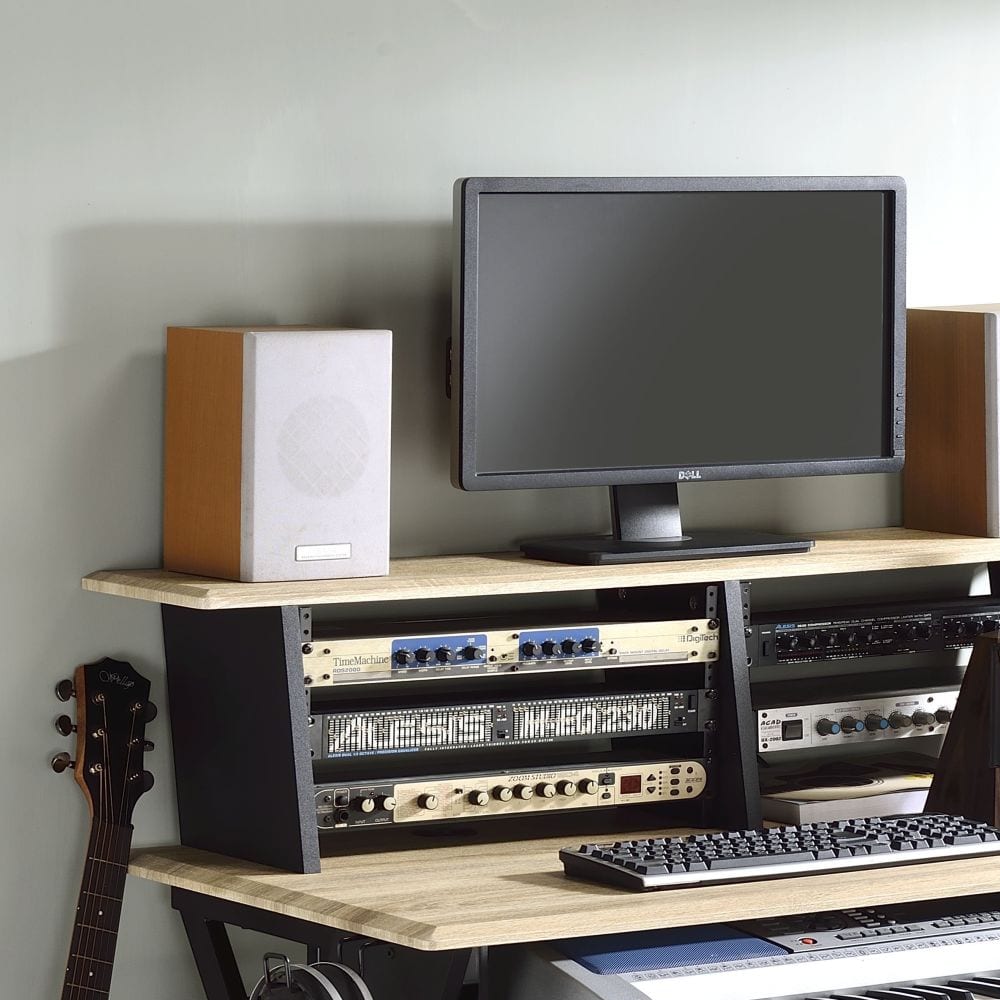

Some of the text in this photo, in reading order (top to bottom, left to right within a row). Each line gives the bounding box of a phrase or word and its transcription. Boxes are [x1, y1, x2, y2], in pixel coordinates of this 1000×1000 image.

[678, 470, 702, 480] DELL
[686, 634, 719, 643] DigiTech
[332, 655, 390, 667] TimeMachine
